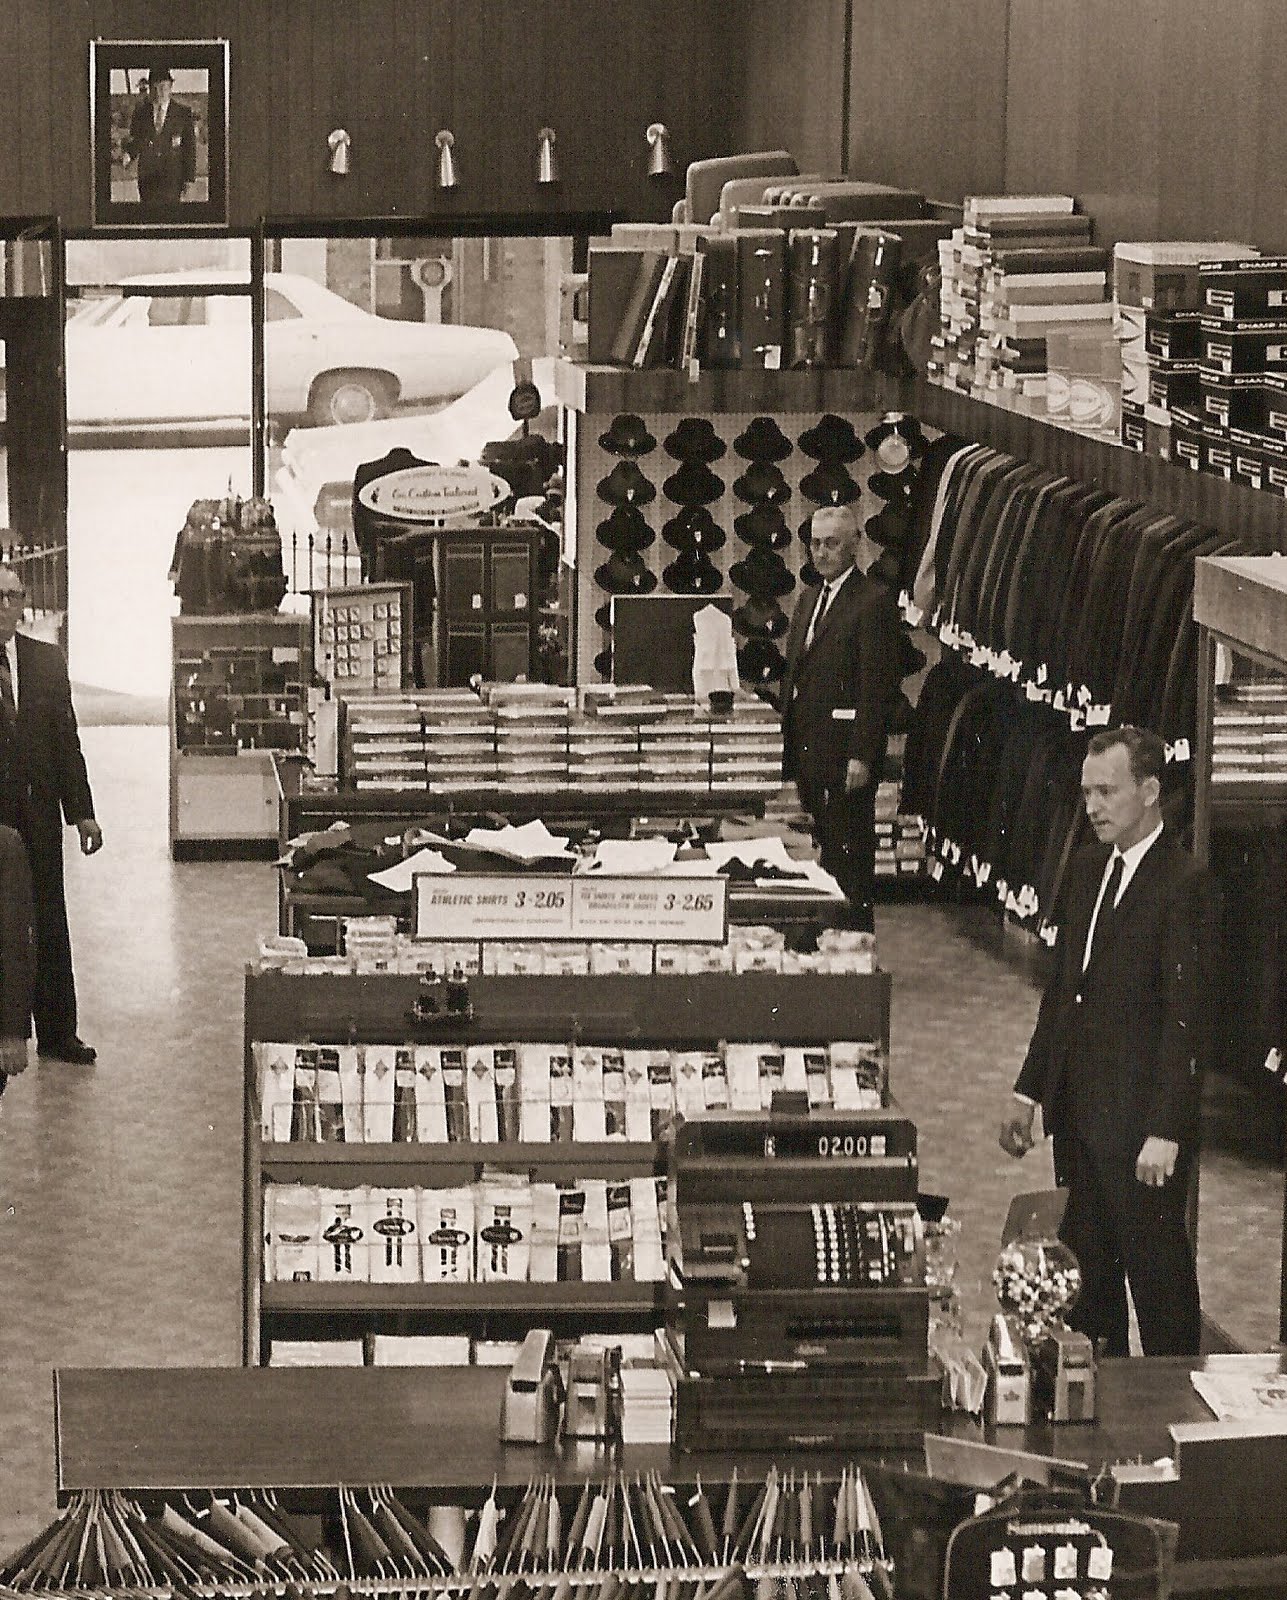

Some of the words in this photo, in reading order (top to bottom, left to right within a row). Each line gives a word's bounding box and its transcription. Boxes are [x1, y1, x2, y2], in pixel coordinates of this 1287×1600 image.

[1237, 322, 1277, 330] CHAMP
[430, 894, 473, 906] ATHLETIC
[476, 894, 509, 906] SHIRTS
